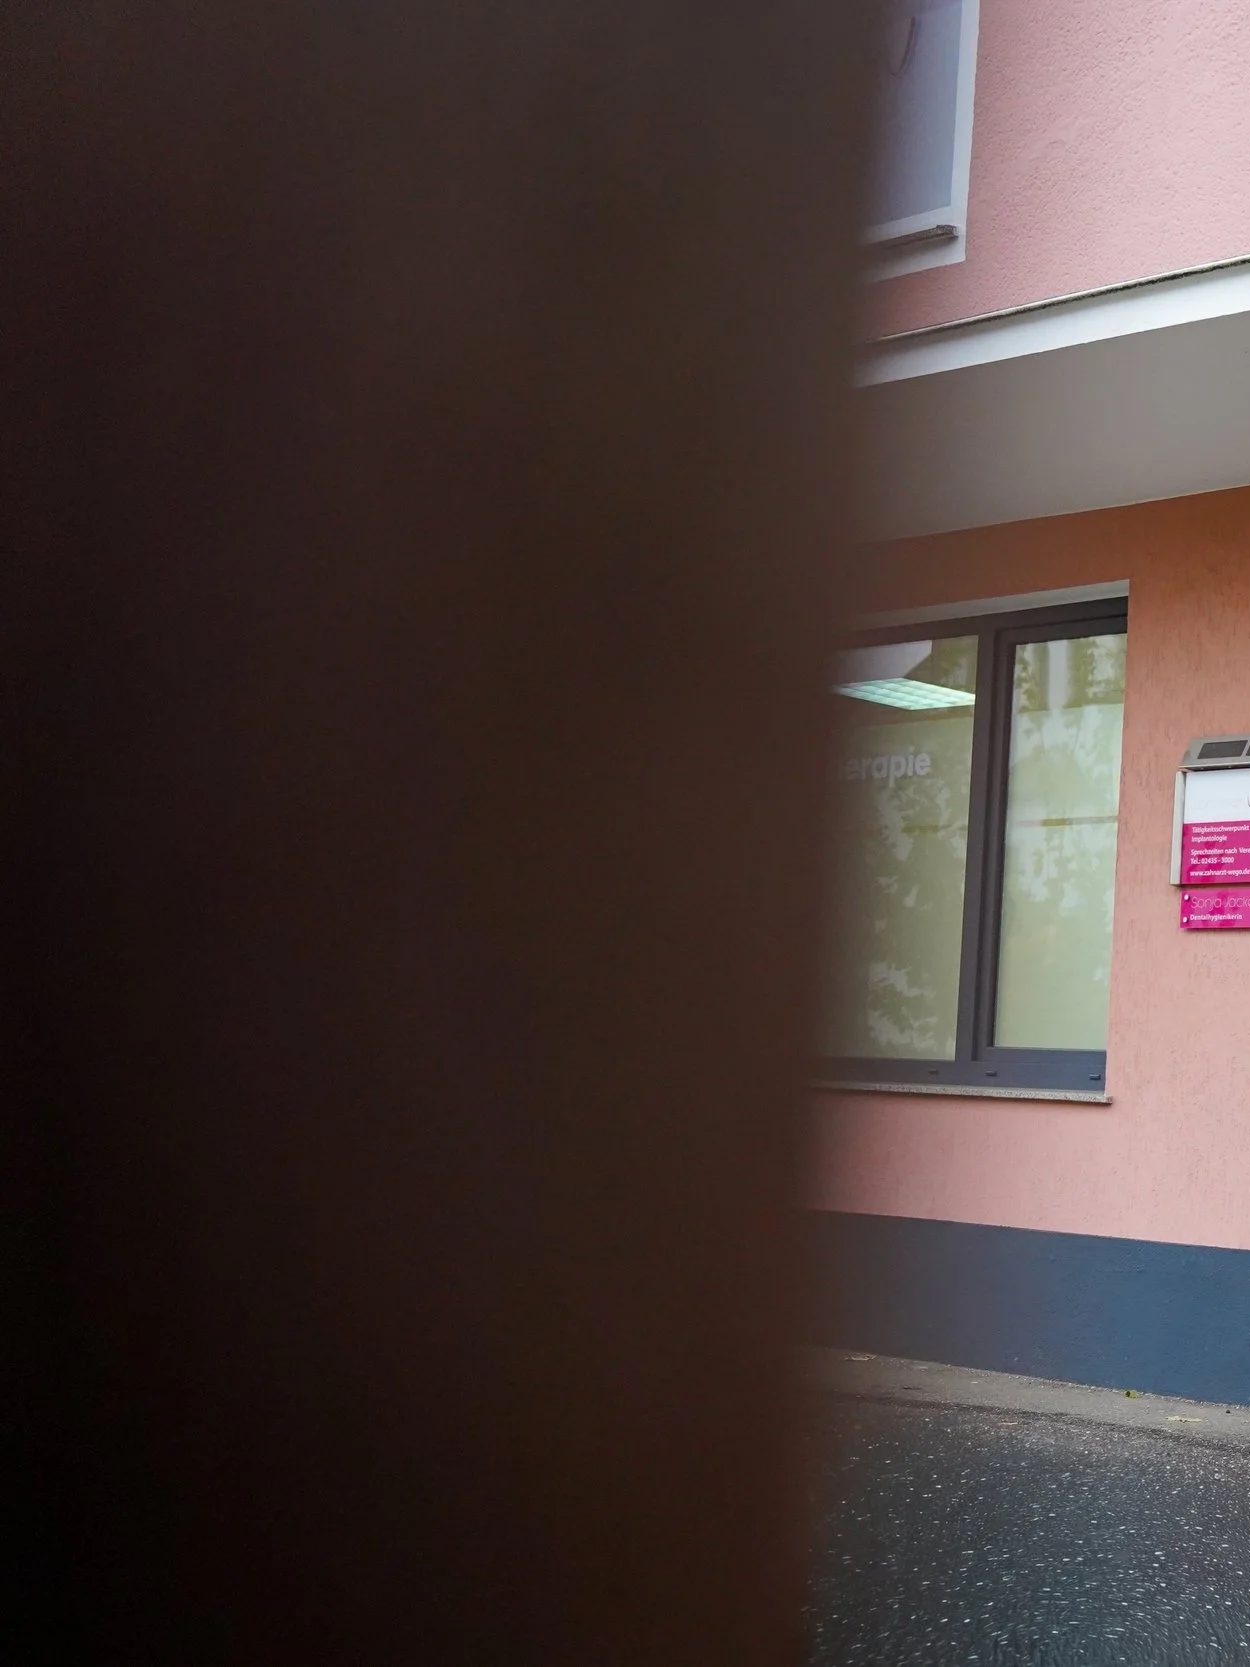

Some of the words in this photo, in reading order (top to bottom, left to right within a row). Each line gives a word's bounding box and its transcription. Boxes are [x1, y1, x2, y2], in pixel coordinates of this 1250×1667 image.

[842, 745, 932, 788] erapie
[1191, 835, 1228, 843] Implantologie
[1190, 848, 1224, 857] Sprechzeiten
[1224, 847, 1238, 855] nach
[1189, 868, 1250, 877] www.zahnarzt-wego.de
[1190, 896, 1222, 911] Sonja
[1190, 913, 1243, 922] Dentalhygienikerin
